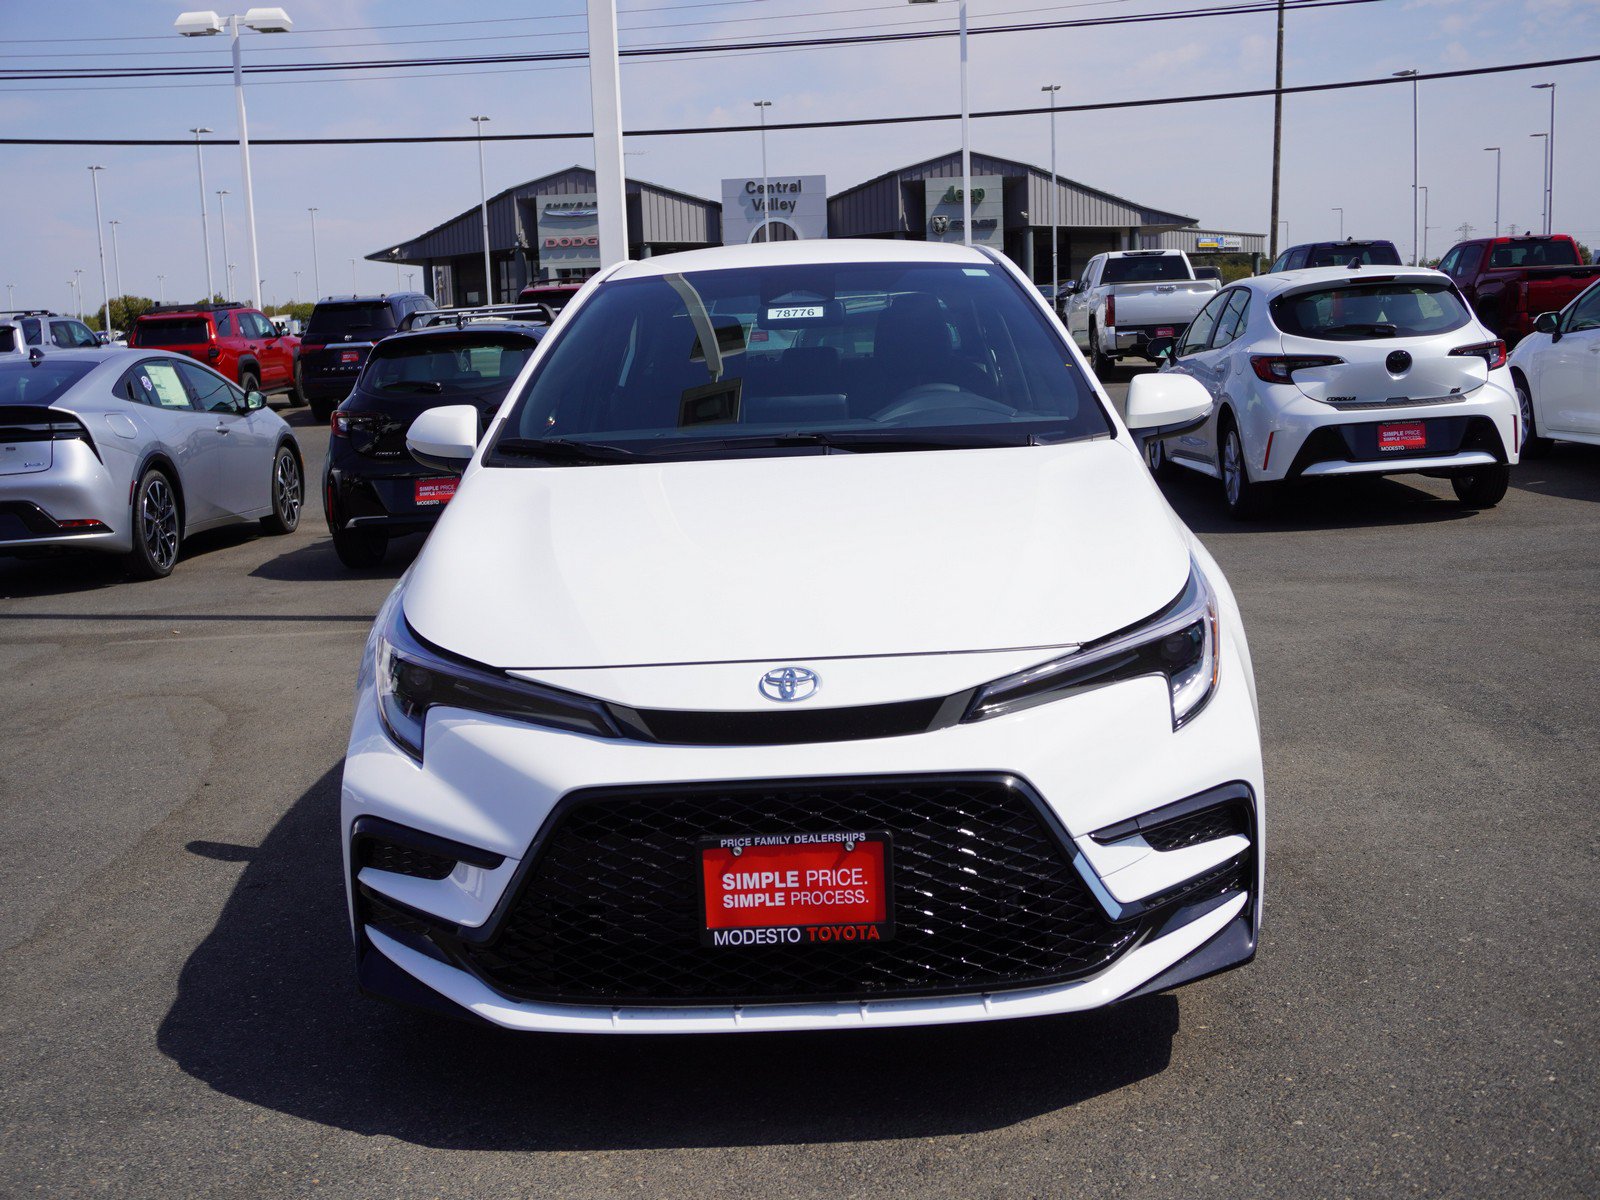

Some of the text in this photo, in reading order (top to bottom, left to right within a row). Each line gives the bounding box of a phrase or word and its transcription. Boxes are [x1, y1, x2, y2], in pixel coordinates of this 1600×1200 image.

[745, 179, 802, 194] Central
[545, 201, 598, 209] CHRYSLE
[545, 236, 598, 248] DODG
[776, 308, 815, 317] 78776
[720, 832, 866, 848] PRICE FAMILY DEALERSHIPS
[722, 868, 868, 891] SIMPLE PRICE.
[723, 889, 869, 909] SIMPLE PROCESS.
[714, 925, 880, 946] MODESTO TOYOTA
